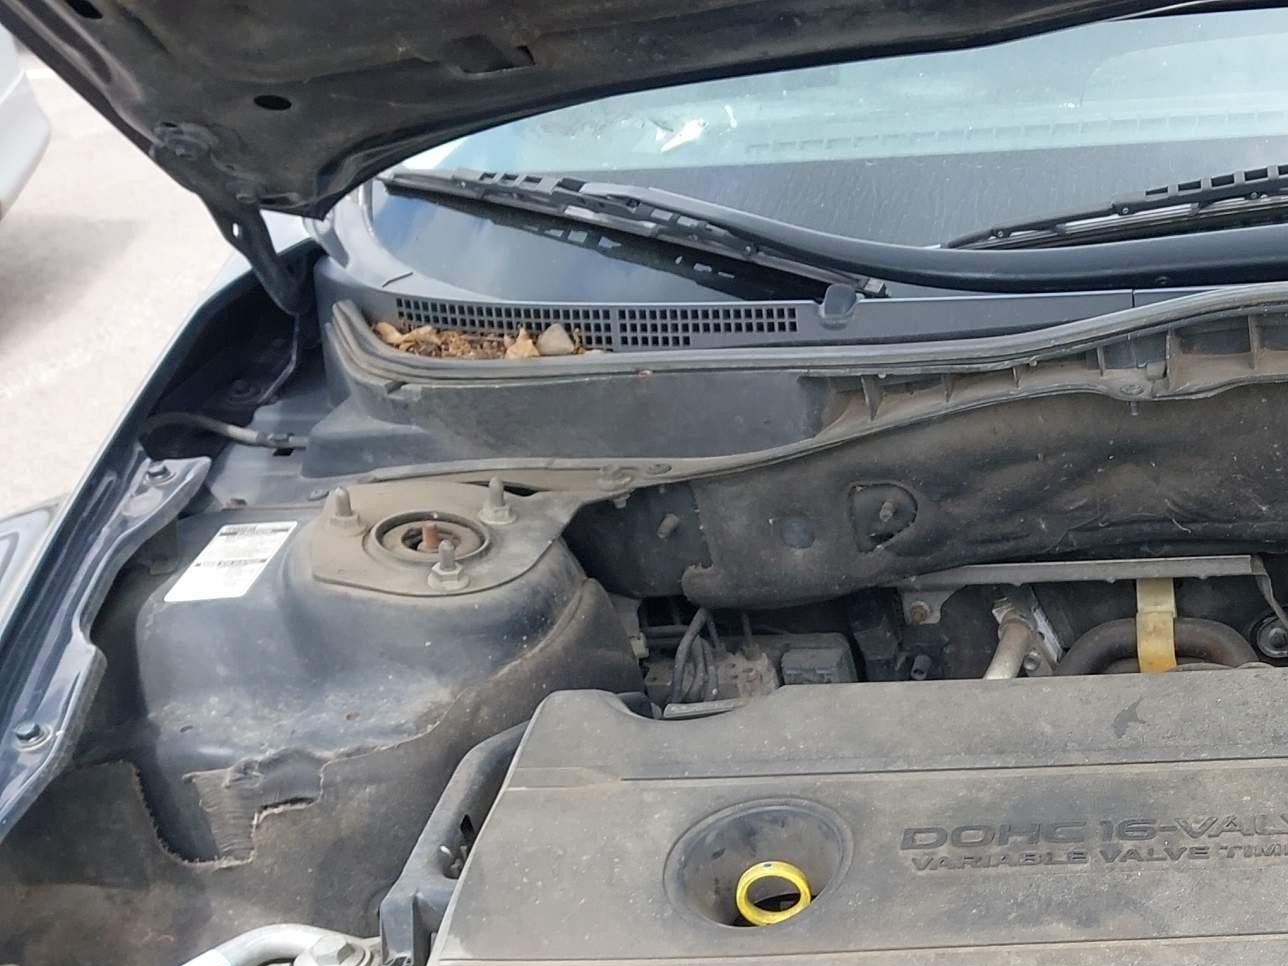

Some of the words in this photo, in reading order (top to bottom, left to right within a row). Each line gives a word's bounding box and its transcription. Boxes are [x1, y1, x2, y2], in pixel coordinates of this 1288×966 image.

[900, 820, 1087, 850] DOHC
[911, 850, 1089, 871] VARIABLE
[1099, 845, 1210, 864] VALVE
